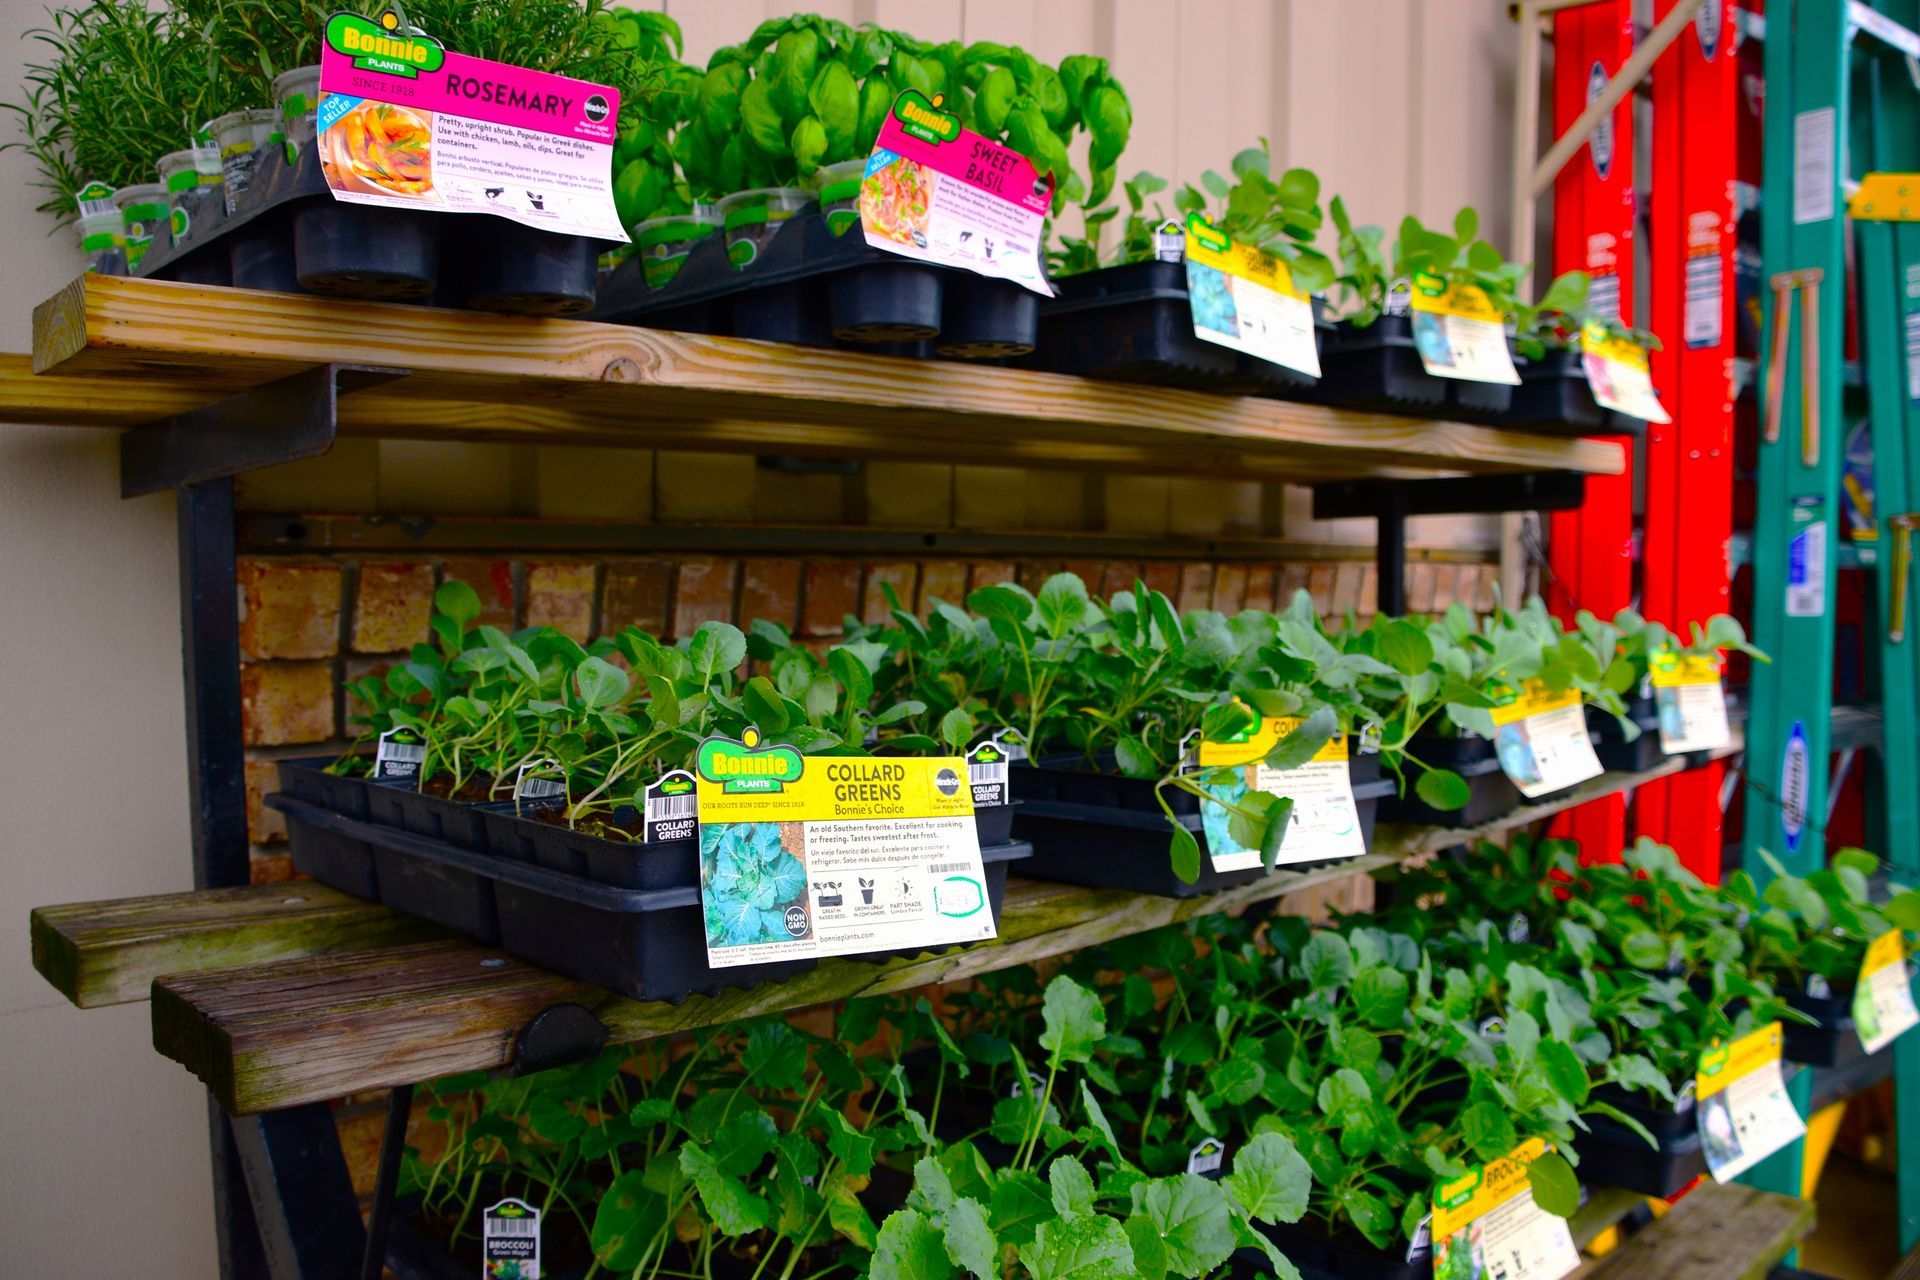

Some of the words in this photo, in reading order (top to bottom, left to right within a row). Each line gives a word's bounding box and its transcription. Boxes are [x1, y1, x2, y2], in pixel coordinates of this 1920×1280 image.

[343, 27, 427, 63] Bonnie
[368, 57, 405, 72] PLANTS
[352, 77, 386, 92] SINCE
[391, 84, 415, 97] 1918
[446, 73, 574, 117] ROSEMARY
[323, 97, 340, 112] TOP
[323, 100, 351, 124] SELLER
[902, 101, 952, 135] Bonnie
[439, 115, 464, 128] Pretty,
[465, 122, 492, 132] upright
[494, 127, 515, 137] shrub.
[517, 130, 541, 141] Popular
[552, 136, 571, 147] Greek
[573, 141, 595, 151] dishes.
[911, 125, 934, 140] PLANTS
[437, 138, 478, 150] containers.
[438, 126, 452, 135] Use
[454, 130, 469, 138] with
[471, 132, 500, 144] chicken,
[502, 138, 521, 148] lamb,
[522, 142, 536, 152] oils,
[538, 145, 554, 154] dips.
[556, 148, 574, 158] Great
[576, 151, 584, 159] for
[970, 142, 1018, 176] SWEET
[966, 162, 1004, 193] BASIL
[712, 753, 788, 775] Bonnie
[827, 764, 905, 782] COLLARD
[737, 780, 770, 788] PLANTS
[973, 785, 1000, 794] COLLARD
[834, 784, 901, 802] GREENS
[975, 793, 998, 801] GREENS
[834, 804, 872, 815] Bonnie's
[877, 803, 904, 814] Choice
[656, 820, 695, 832] COLLARD
[810, 826, 820, 834] An
[821, 824, 832, 833] old
[833, 824, 864, 833] Southern
[866, 824, 892, 832] favorite.
[894, 822, 924, 830] Excellent
[936, 821, 962, 830] cooking
[658, 829, 692, 840] GREENS
[819, 835, 850, 844] freezing.
[851, 834, 871, 842] Tastes
[872, 833, 901, 841] sweetest
[902, 832, 919, 840] after
[821, 848, 835, 857] viejo
[836, 847, 859, 855] favorito
[882, 845, 910, 853] Excelente
[811, 858, 842, 866] refrigerar.
[843, 856, 857, 864] Sabe
[787, 914, 805, 922] NON
[788, 921, 806, 930] GMO
[820, 932, 874, 943] bonnieplants.com
[489, 1241, 534, 1249] BROCCOLI
